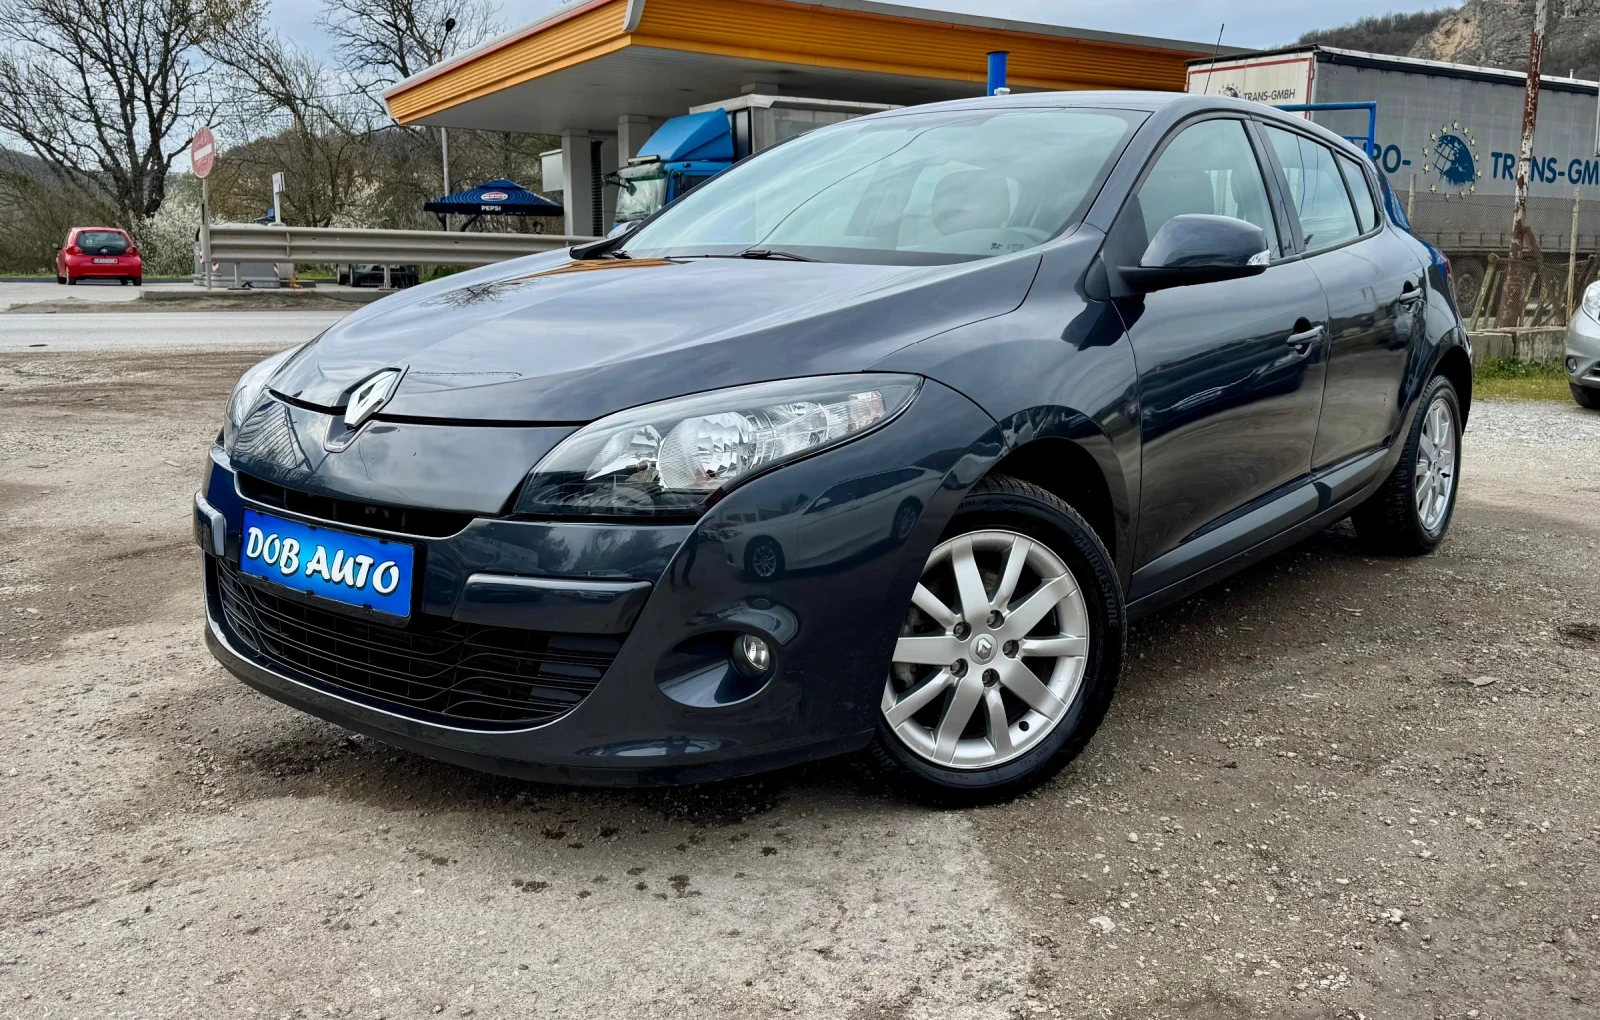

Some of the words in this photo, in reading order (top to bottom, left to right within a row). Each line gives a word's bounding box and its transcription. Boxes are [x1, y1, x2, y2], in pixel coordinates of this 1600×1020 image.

[1243, 89, 1296, 102] TRANS-GMBH
[1491, 152, 1600, 185] TRNS-GM
[246, 527, 300, 574] DOB
[305, 545, 400, 594] AUTO
